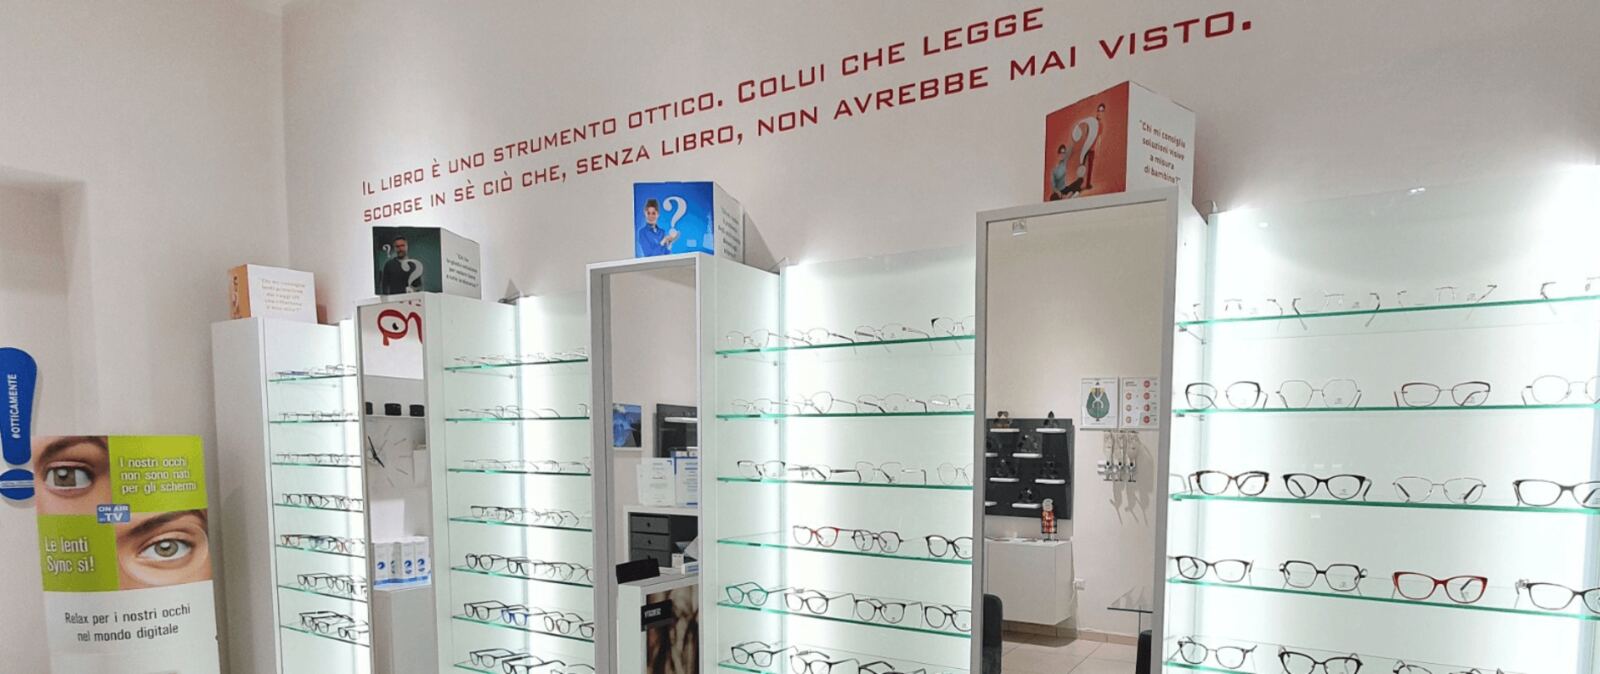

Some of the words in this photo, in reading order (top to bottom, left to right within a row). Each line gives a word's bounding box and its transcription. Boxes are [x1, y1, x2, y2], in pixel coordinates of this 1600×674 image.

[381, 168, 424, 191] LIBRO
[431, 158, 441, 178] È
[448, 152, 485, 174] UNO
[493, 118, 616, 163] STRUMENTO
[628, 92, 723, 129] OTTICO.
[737, 64, 824, 104] COLUI
[841, 42, 905, 76] CHE
[923, 7, 1043, 56] LEGGE
[363, 197, 423, 223] SCORGE
[430, 191, 446, 207] IN
[454, 179, 475, 202] SÈ
[483, 170, 513, 196] CIÒ
[522, 164, 566, 188] CHE,
[576, 145, 650, 175] SENZA
[661, 125, 743, 157] LIBRO,
[758, 106, 818, 137] NON
[833, 66, 989, 120] AVREBBE
[1010, 46, 1076, 81] MAI
[1099, 11, 1252, 60] VISTO.
[1154, 155, 1175, 170] misura
[7, 373, 21, 439] #OTTICAMENTE
[119, 457, 124, 468] I
[128, 457, 159, 468] nostri
[162, 456, 187, 467] occhi
[121, 472, 140, 481] non
[144, 471, 169, 480] sono
[122, 484, 139, 495] per
[144, 481, 157, 494] gli
[160, 481, 197, 492] schermi
[104, 512, 123, 522] TV
[45, 535, 57, 552] Le
[60, 536, 88, 553] lenti
[47, 555, 73, 575] Sync
[64, 612, 89, 624] Relax
[92, 614, 110, 626] per
[114, 611, 118, 623] i
[122, 608, 157, 623] nostri
[162, 602, 191, 618] occhi
[77, 630, 91, 642] nel
[94, 628, 132, 642] mondo
[136, 623, 179, 640] digitale
